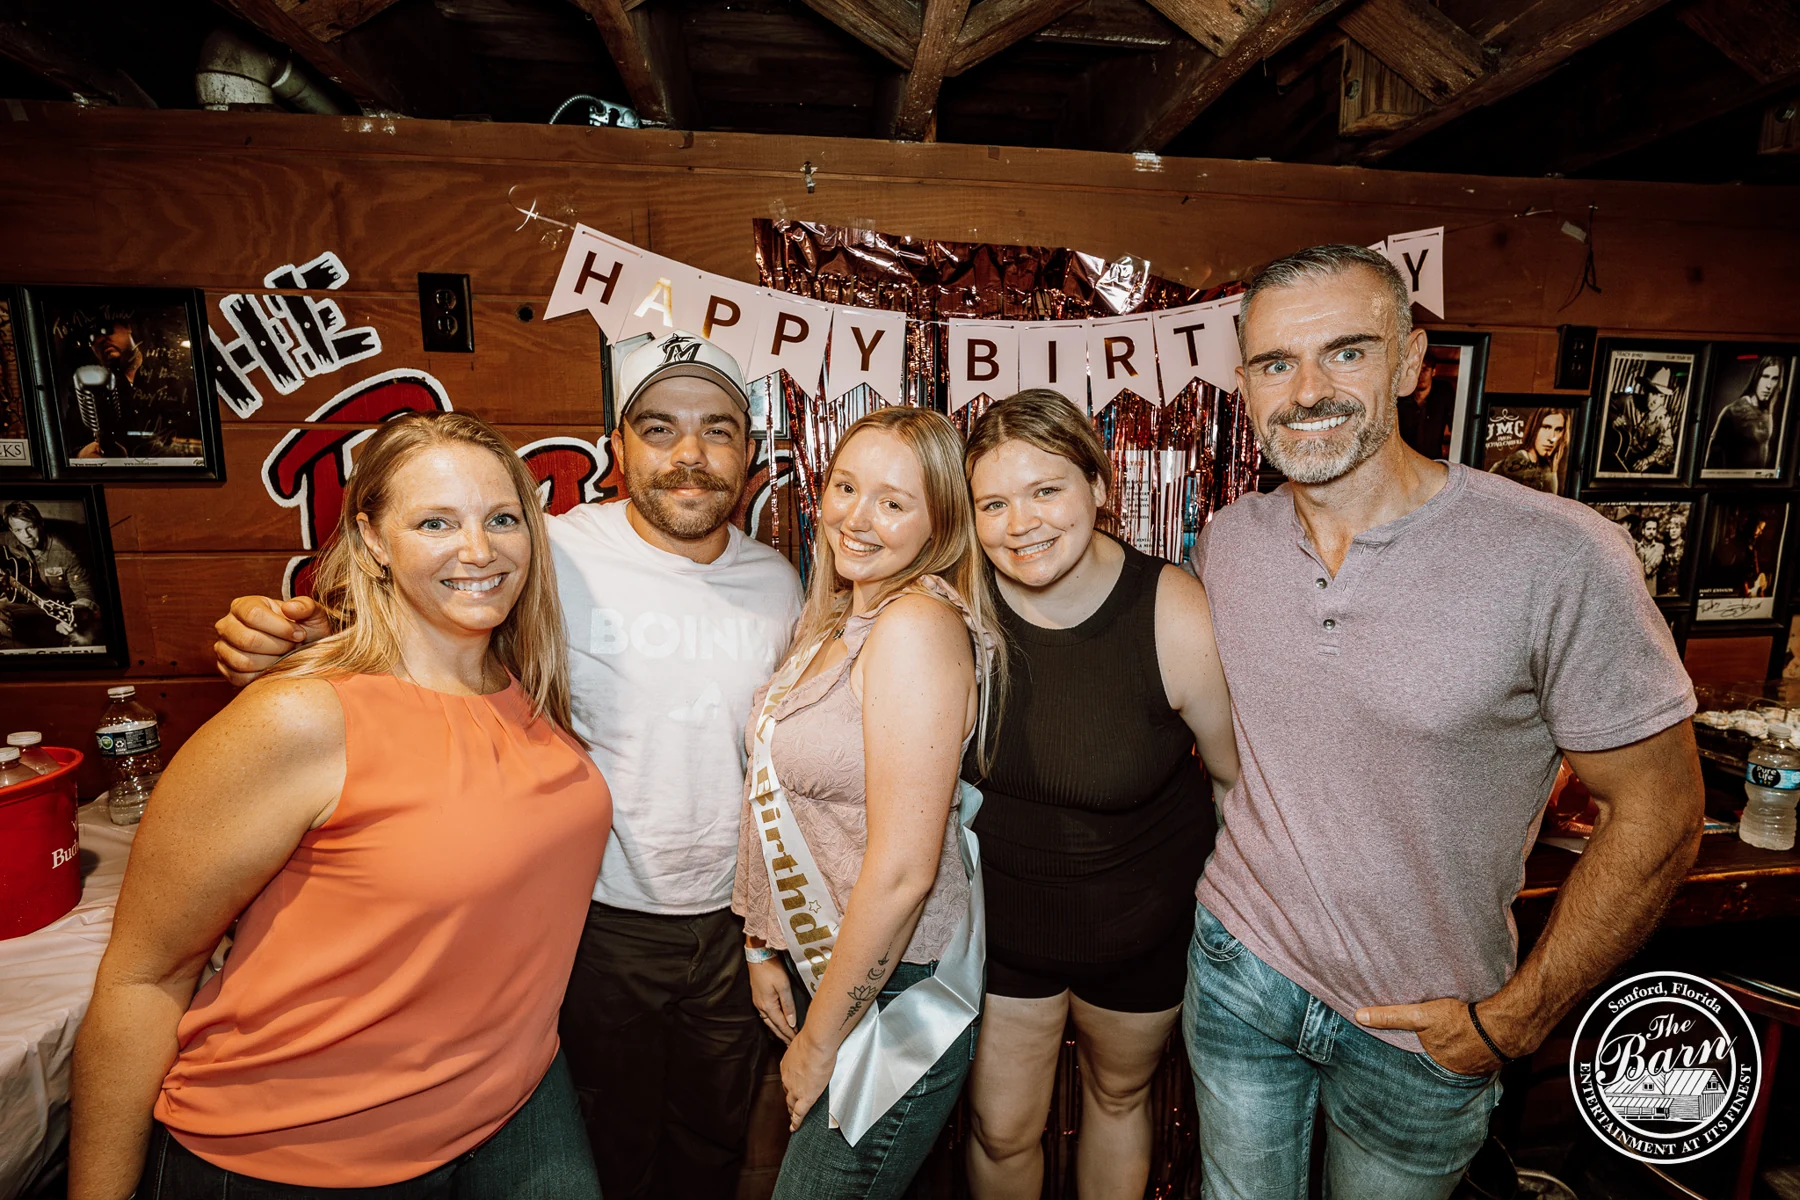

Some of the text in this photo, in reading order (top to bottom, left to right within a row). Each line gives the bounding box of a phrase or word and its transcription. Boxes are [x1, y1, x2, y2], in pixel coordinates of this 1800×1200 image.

[573, 250, 886, 372] HAPPY
[1486, 420, 1525, 441] JMC
[0, 444, 22, 458] KS
[1756, 765, 1777, 775] Pure
[1757, 772, 1774, 781] Life
[51, 838, 79, 869] Bud
[754, 765, 834, 993] Birthda
